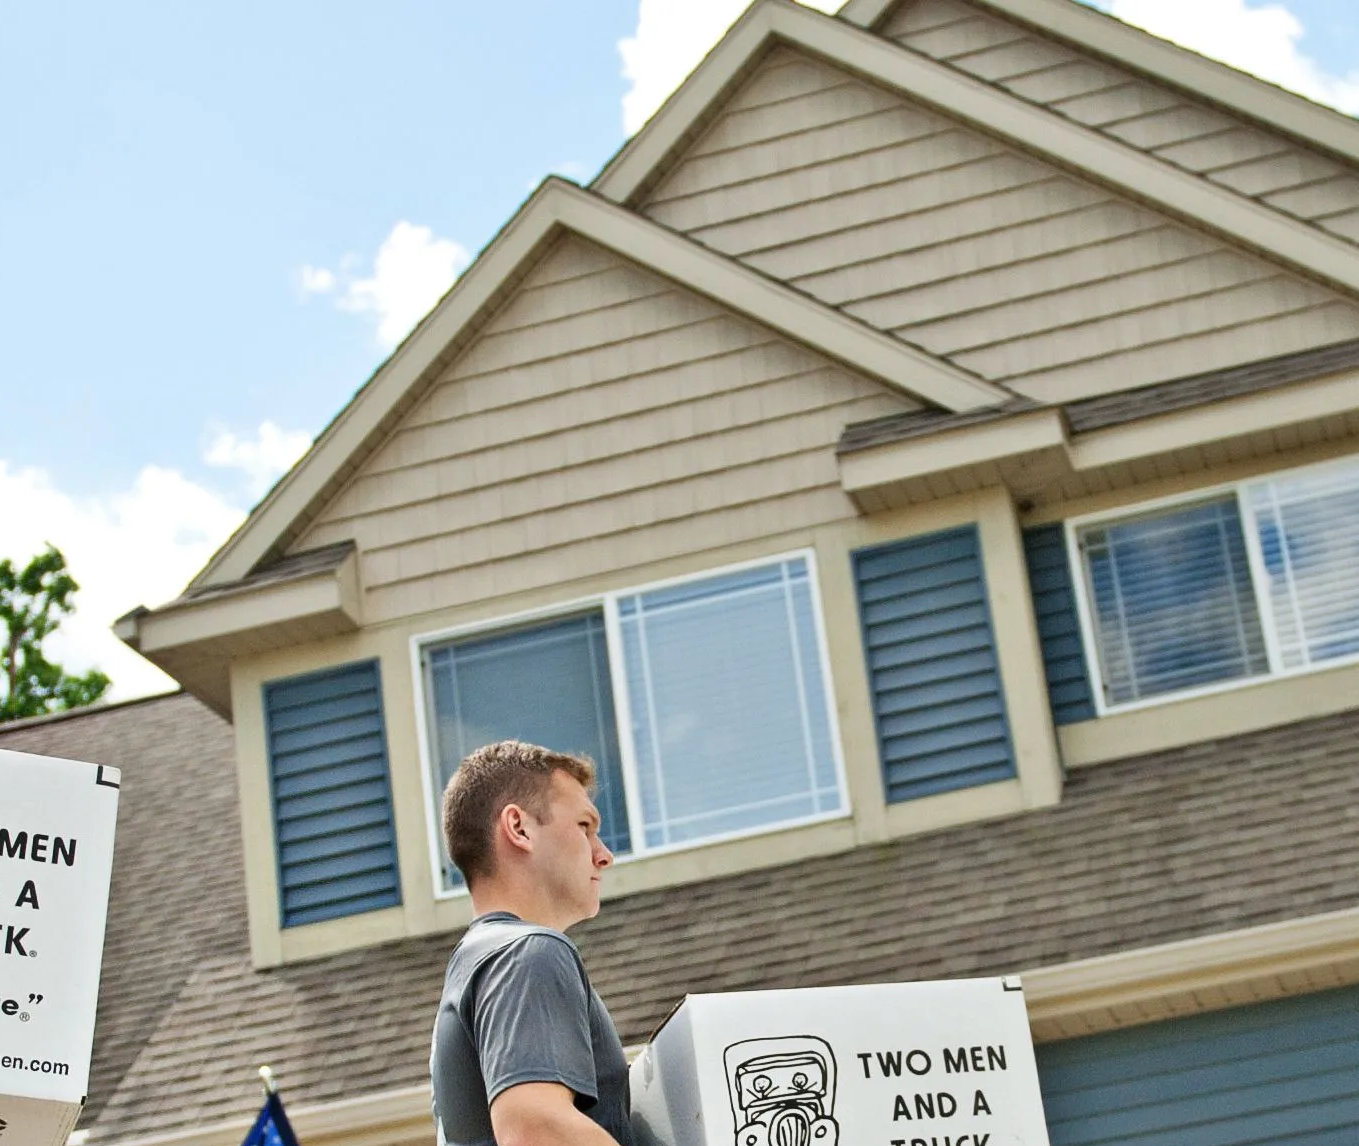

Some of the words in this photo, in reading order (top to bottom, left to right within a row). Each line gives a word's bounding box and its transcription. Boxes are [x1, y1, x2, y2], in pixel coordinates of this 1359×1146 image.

[15, 880, 39, 909] A
[857, 1050, 931, 1078] TWO
[943, 1046, 1006, 1073] MEN
[893, 1093, 956, 1121] AND
[973, 1090, 991, 1115] A
